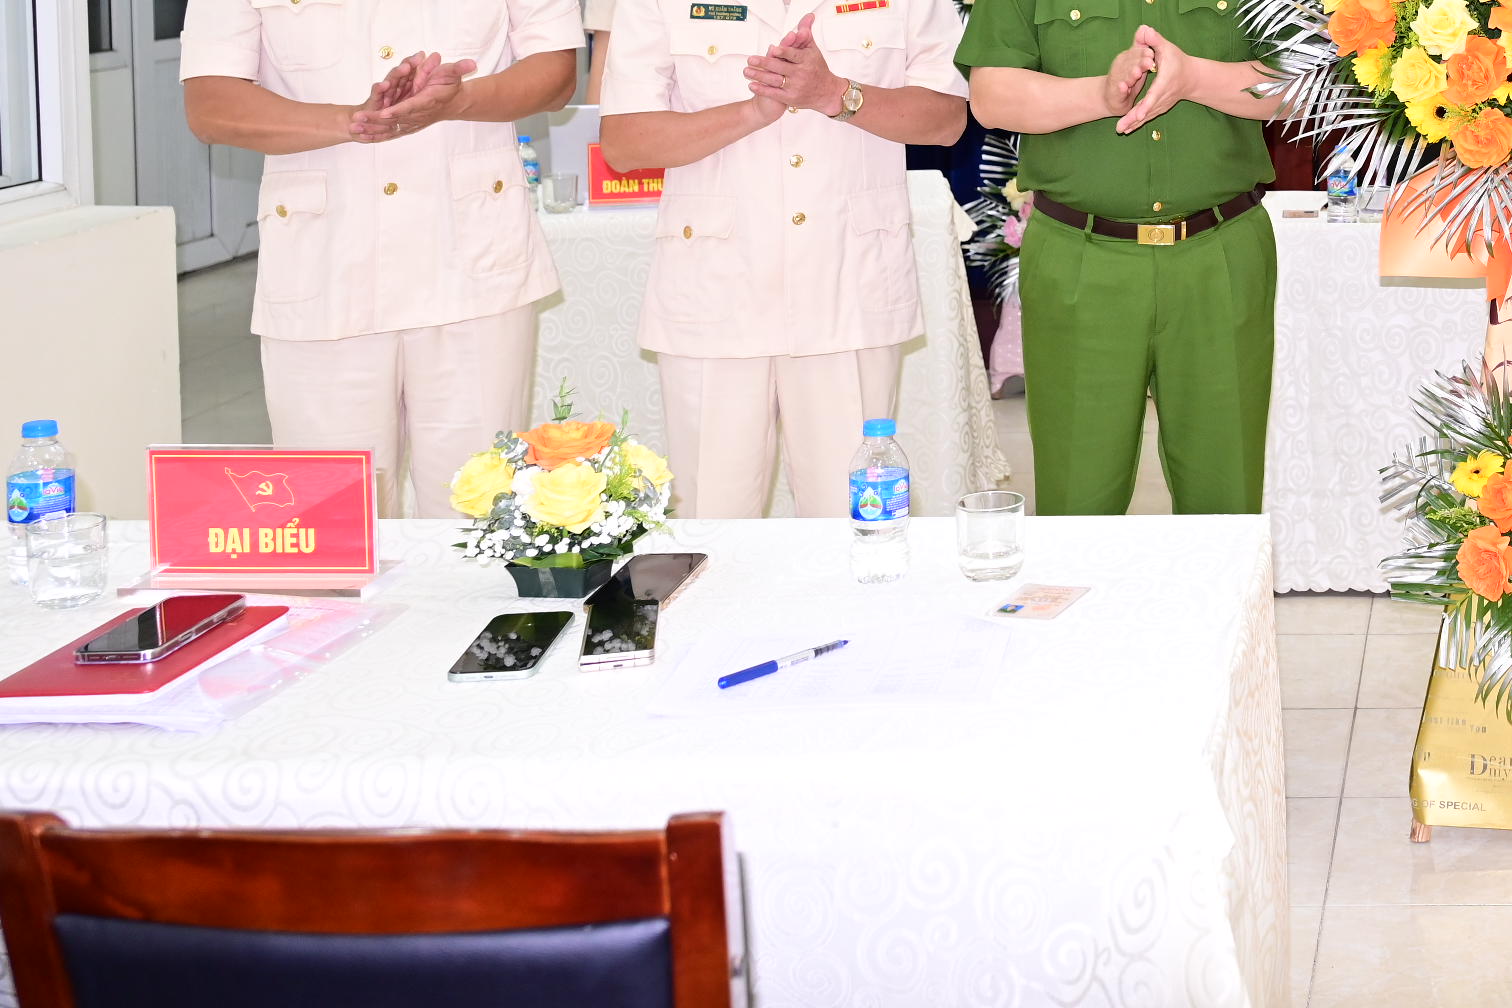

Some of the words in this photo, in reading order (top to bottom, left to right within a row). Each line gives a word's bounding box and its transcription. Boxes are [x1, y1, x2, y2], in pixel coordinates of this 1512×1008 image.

[207, 527, 251, 559] ĐẠI
[258, 517, 316, 554] BIỂU
[1421, 799, 1436, 808] OF
[1438, 800, 1488, 812] SPECIAL
